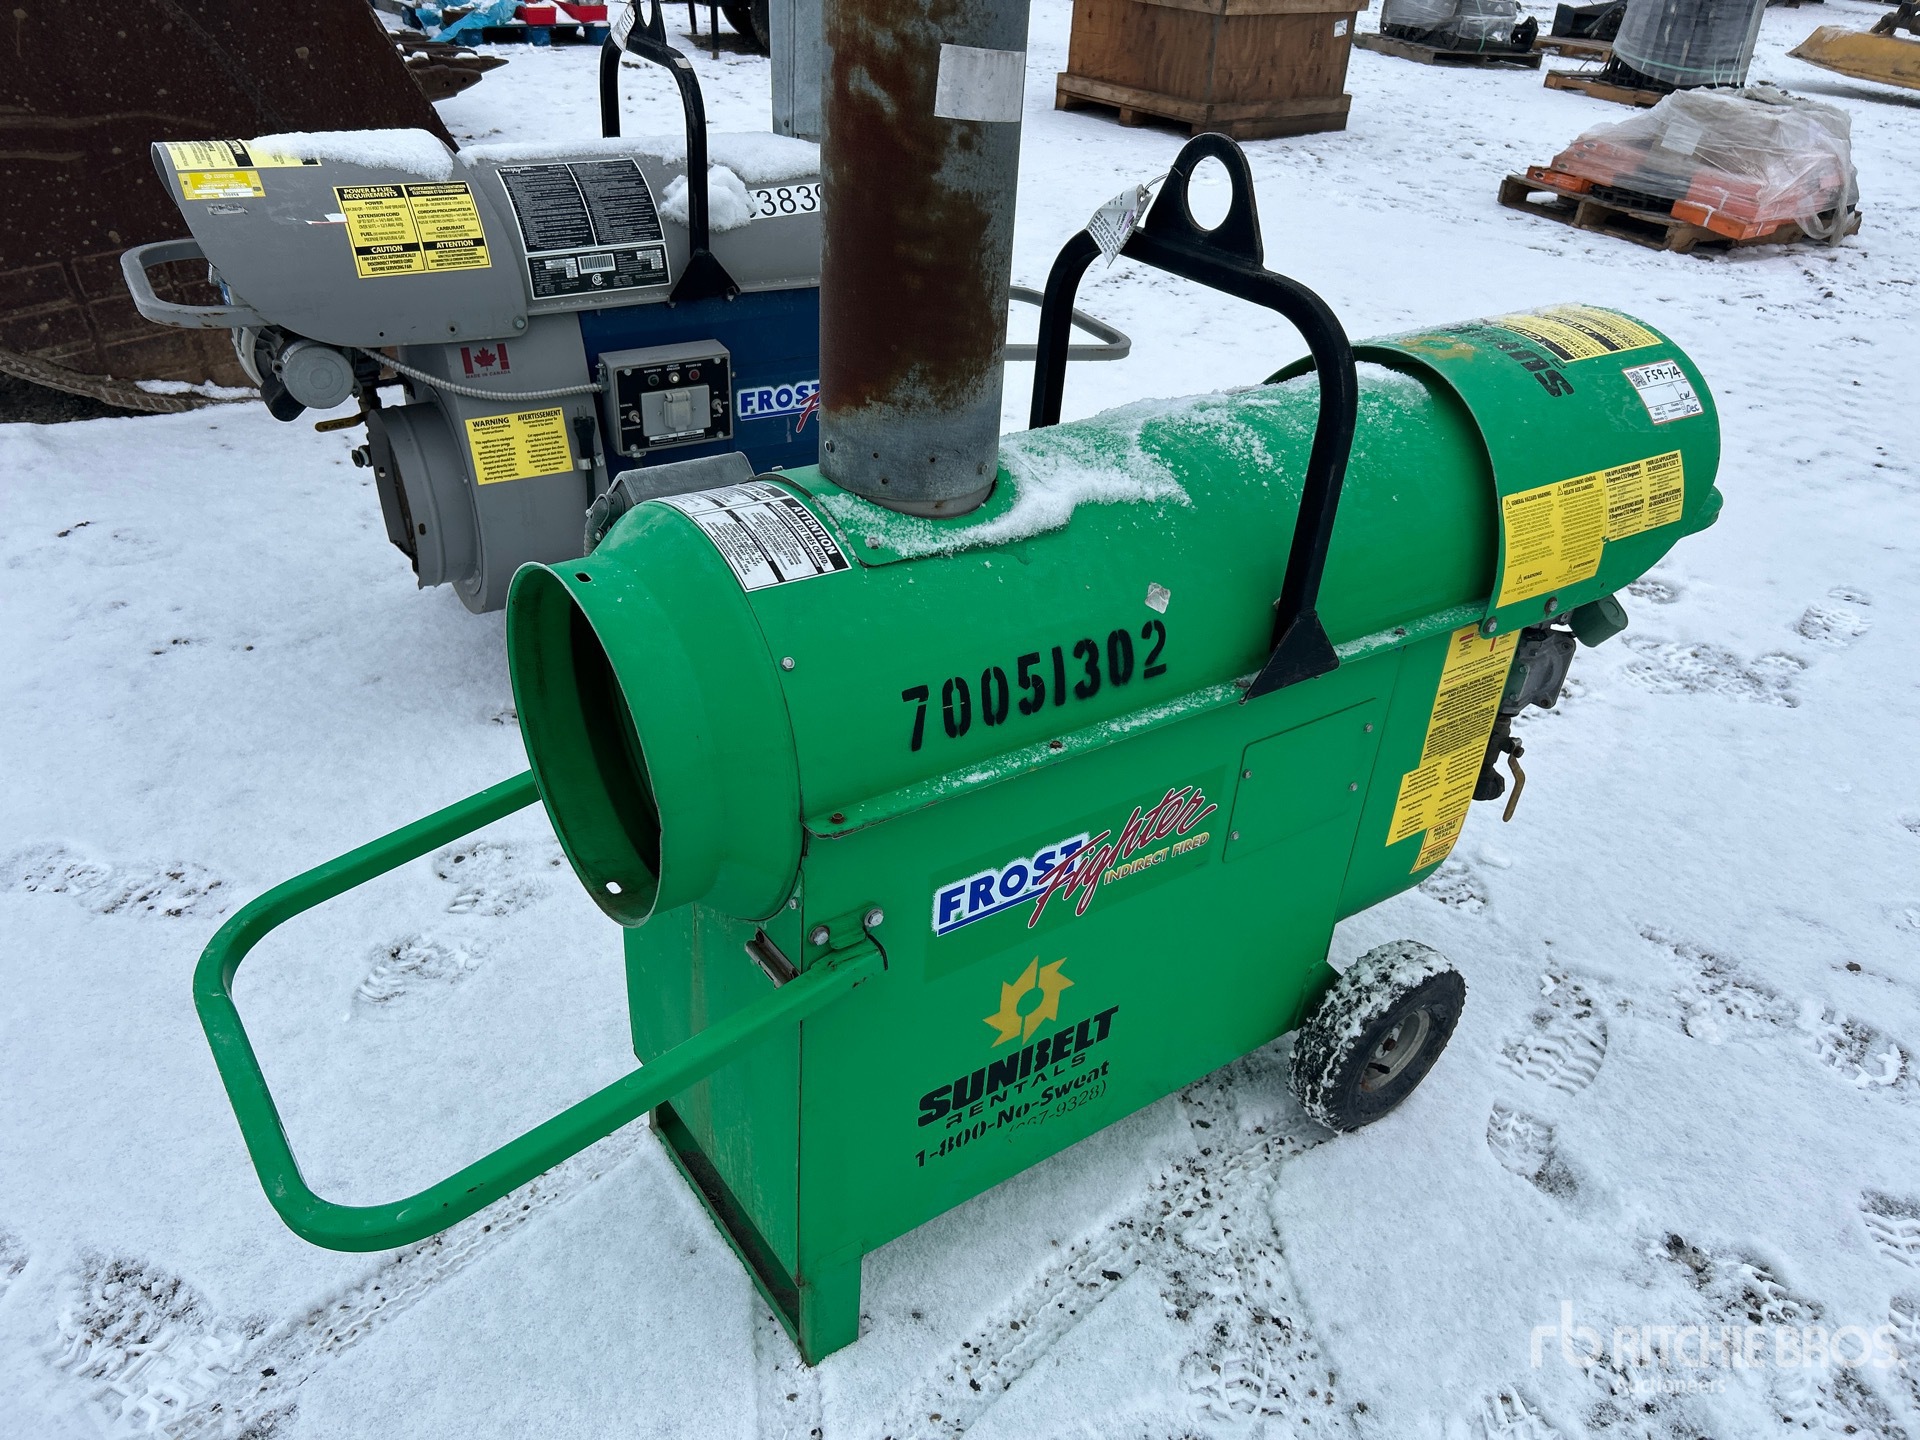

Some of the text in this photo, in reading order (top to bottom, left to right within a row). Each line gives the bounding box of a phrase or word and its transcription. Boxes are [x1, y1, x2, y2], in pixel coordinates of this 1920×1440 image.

[371, 245, 403, 254] CAUTION
[436, 240, 474, 249] ATTENTION
[1644, 366, 1681, 382] F59-14
[472, 417, 509, 428] WARNING
[517, 410, 561, 421] AVERTISSEMENT
[1659, 453, 1678, 463] APPLICATIONS
[1611, 466, 1631, 476] APPLICATIONS
[1511, 497, 1524, 506] GENERAL
[1537, 491, 1552, 499] WARNING
[1662, 488, 1681, 497] APPLICATIONS
[1614, 501, 1634, 512] APPLICATIONS
[791, 507, 838, 555] ATTENTION
[812, 545, 829, 566] CHAUD.
[1523, 571, 1543, 580] WARNING
[1480, 669, 1505, 683] INHALATION
[901, 619, 1167, 752] 70051302
[1434, 825, 1456, 837] PRESSURE
[936, 786, 1218, 928] FROST Fighter
[1104, 831, 1210, 885] INDIRECT FIRED
[918, 1004, 1119, 1127] SUNBELT
[946, 1052, 1086, 1130] RENTALS
[915, 1060, 1110, 1168] 1-800-No-Sweat
